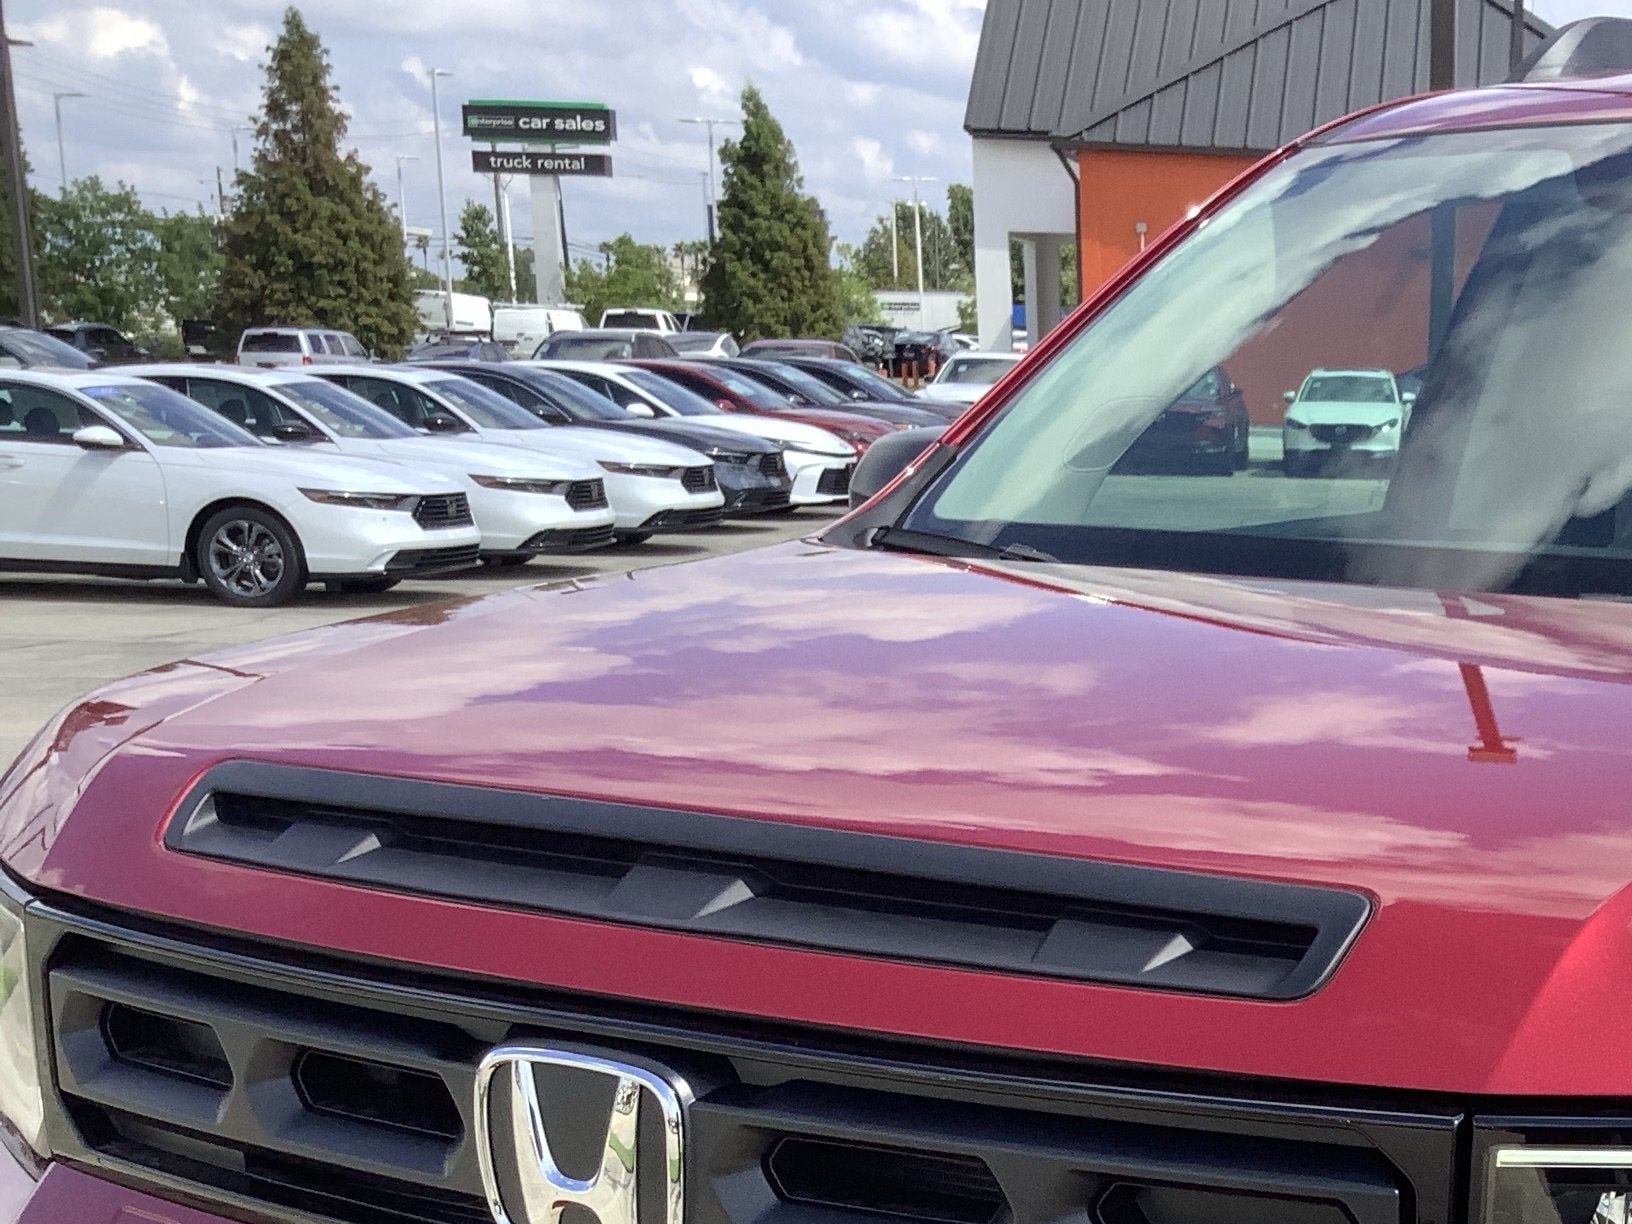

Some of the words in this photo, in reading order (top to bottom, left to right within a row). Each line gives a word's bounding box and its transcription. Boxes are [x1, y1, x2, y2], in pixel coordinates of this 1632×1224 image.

[518, 117, 550, 129] car
[555, 115, 605, 131] sales
[489, 155, 531, 168] truck
[537, 157, 585, 170] rental
